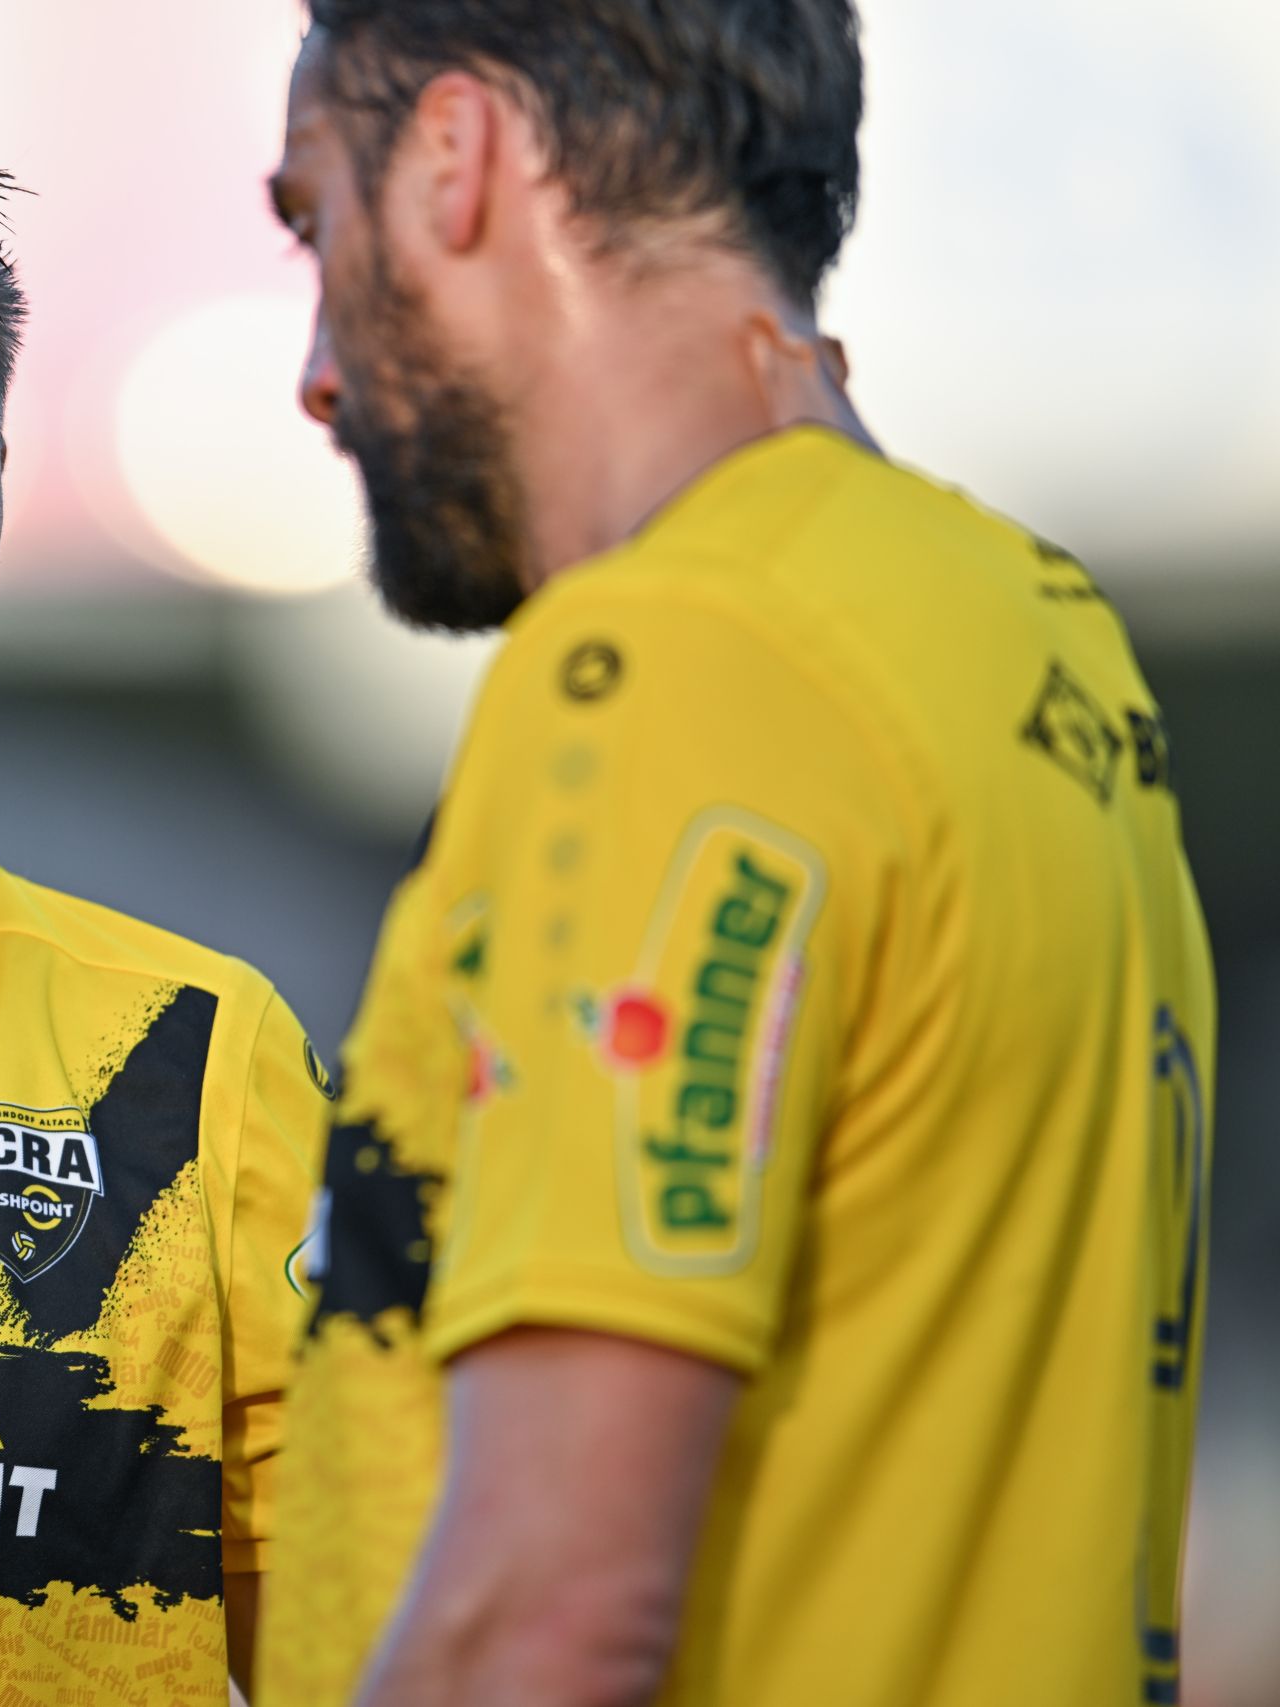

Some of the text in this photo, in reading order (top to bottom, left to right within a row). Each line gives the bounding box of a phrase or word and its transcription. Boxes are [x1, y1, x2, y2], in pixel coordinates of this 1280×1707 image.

[644, 851, 791, 1231] pfanner
[39, 1118, 81, 1127] ALTACH
[135, 1646, 193, 1681] mutig
